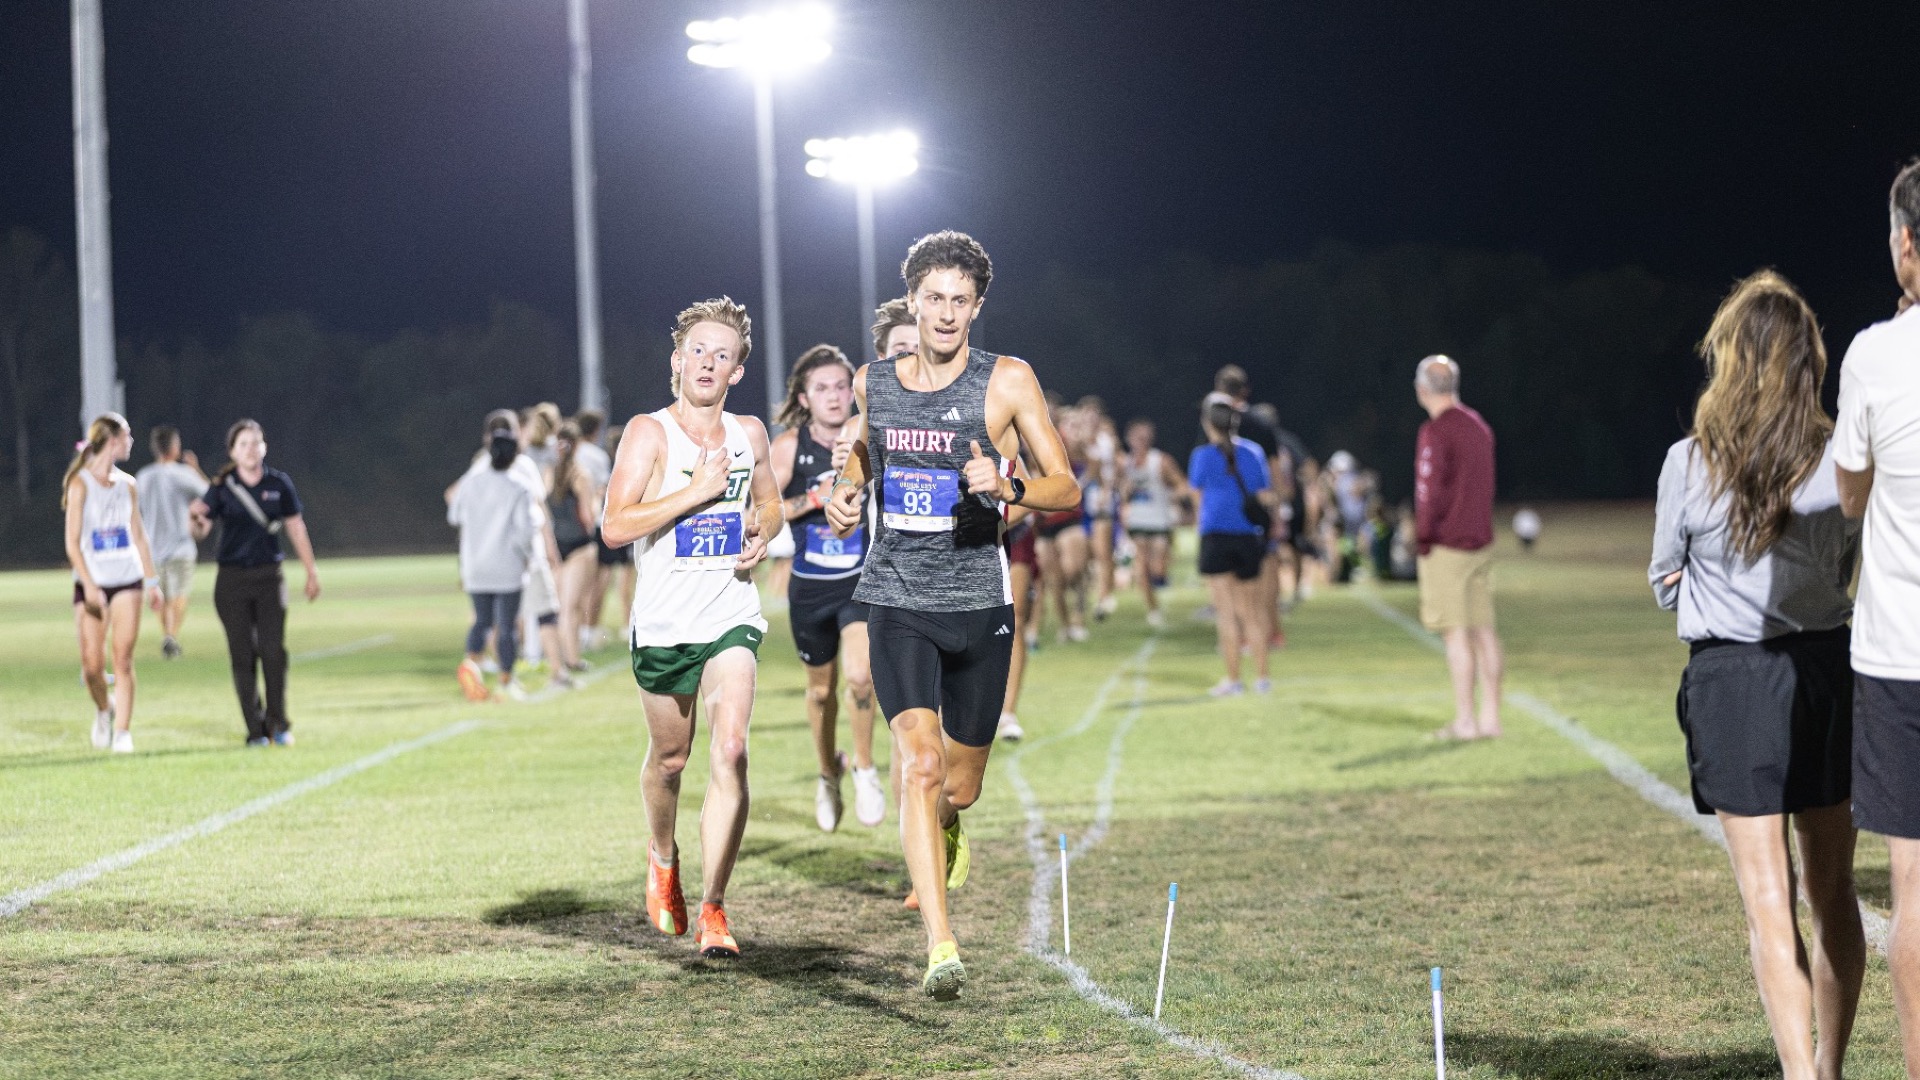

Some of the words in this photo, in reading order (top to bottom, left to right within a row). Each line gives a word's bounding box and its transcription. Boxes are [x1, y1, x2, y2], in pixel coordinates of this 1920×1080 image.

[885, 428, 956, 454] DRURY
[903, 491, 933, 515] 93
[691, 534, 728, 557] 217
